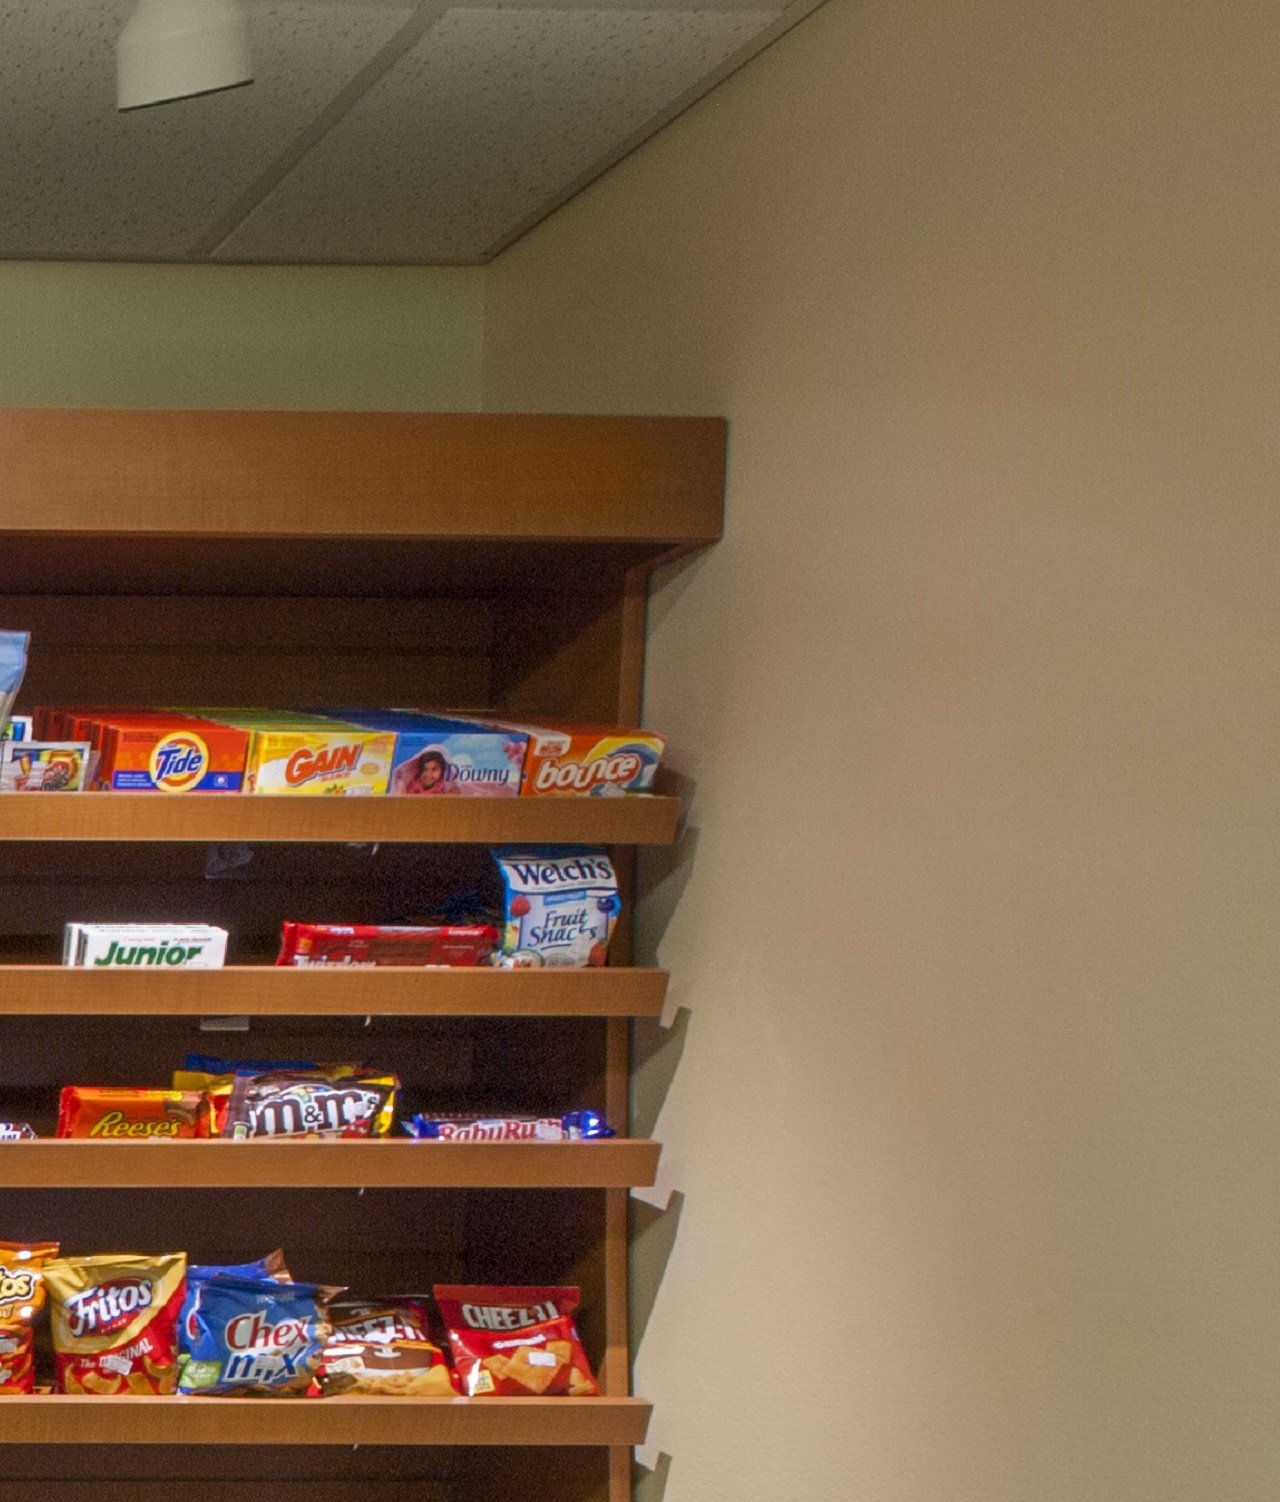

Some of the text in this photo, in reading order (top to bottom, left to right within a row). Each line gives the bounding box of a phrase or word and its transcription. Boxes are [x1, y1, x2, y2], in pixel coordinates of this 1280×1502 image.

[155, 747, 203, 780] Tide
[285, 743, 363, 787] GAIN
[444, 763, 509, 785] Downy
[535, 753, 641, 792] bounce
[512, 857, 614, 885] Welch's
[542, 908, 589, 929] Fruit
[94, 940, 203, 967] Junior
[66, 1279, 153, 1337] Fritos
[226, 1312, 310, 1350] Chex
[80, 1358, 96, 1369] The
